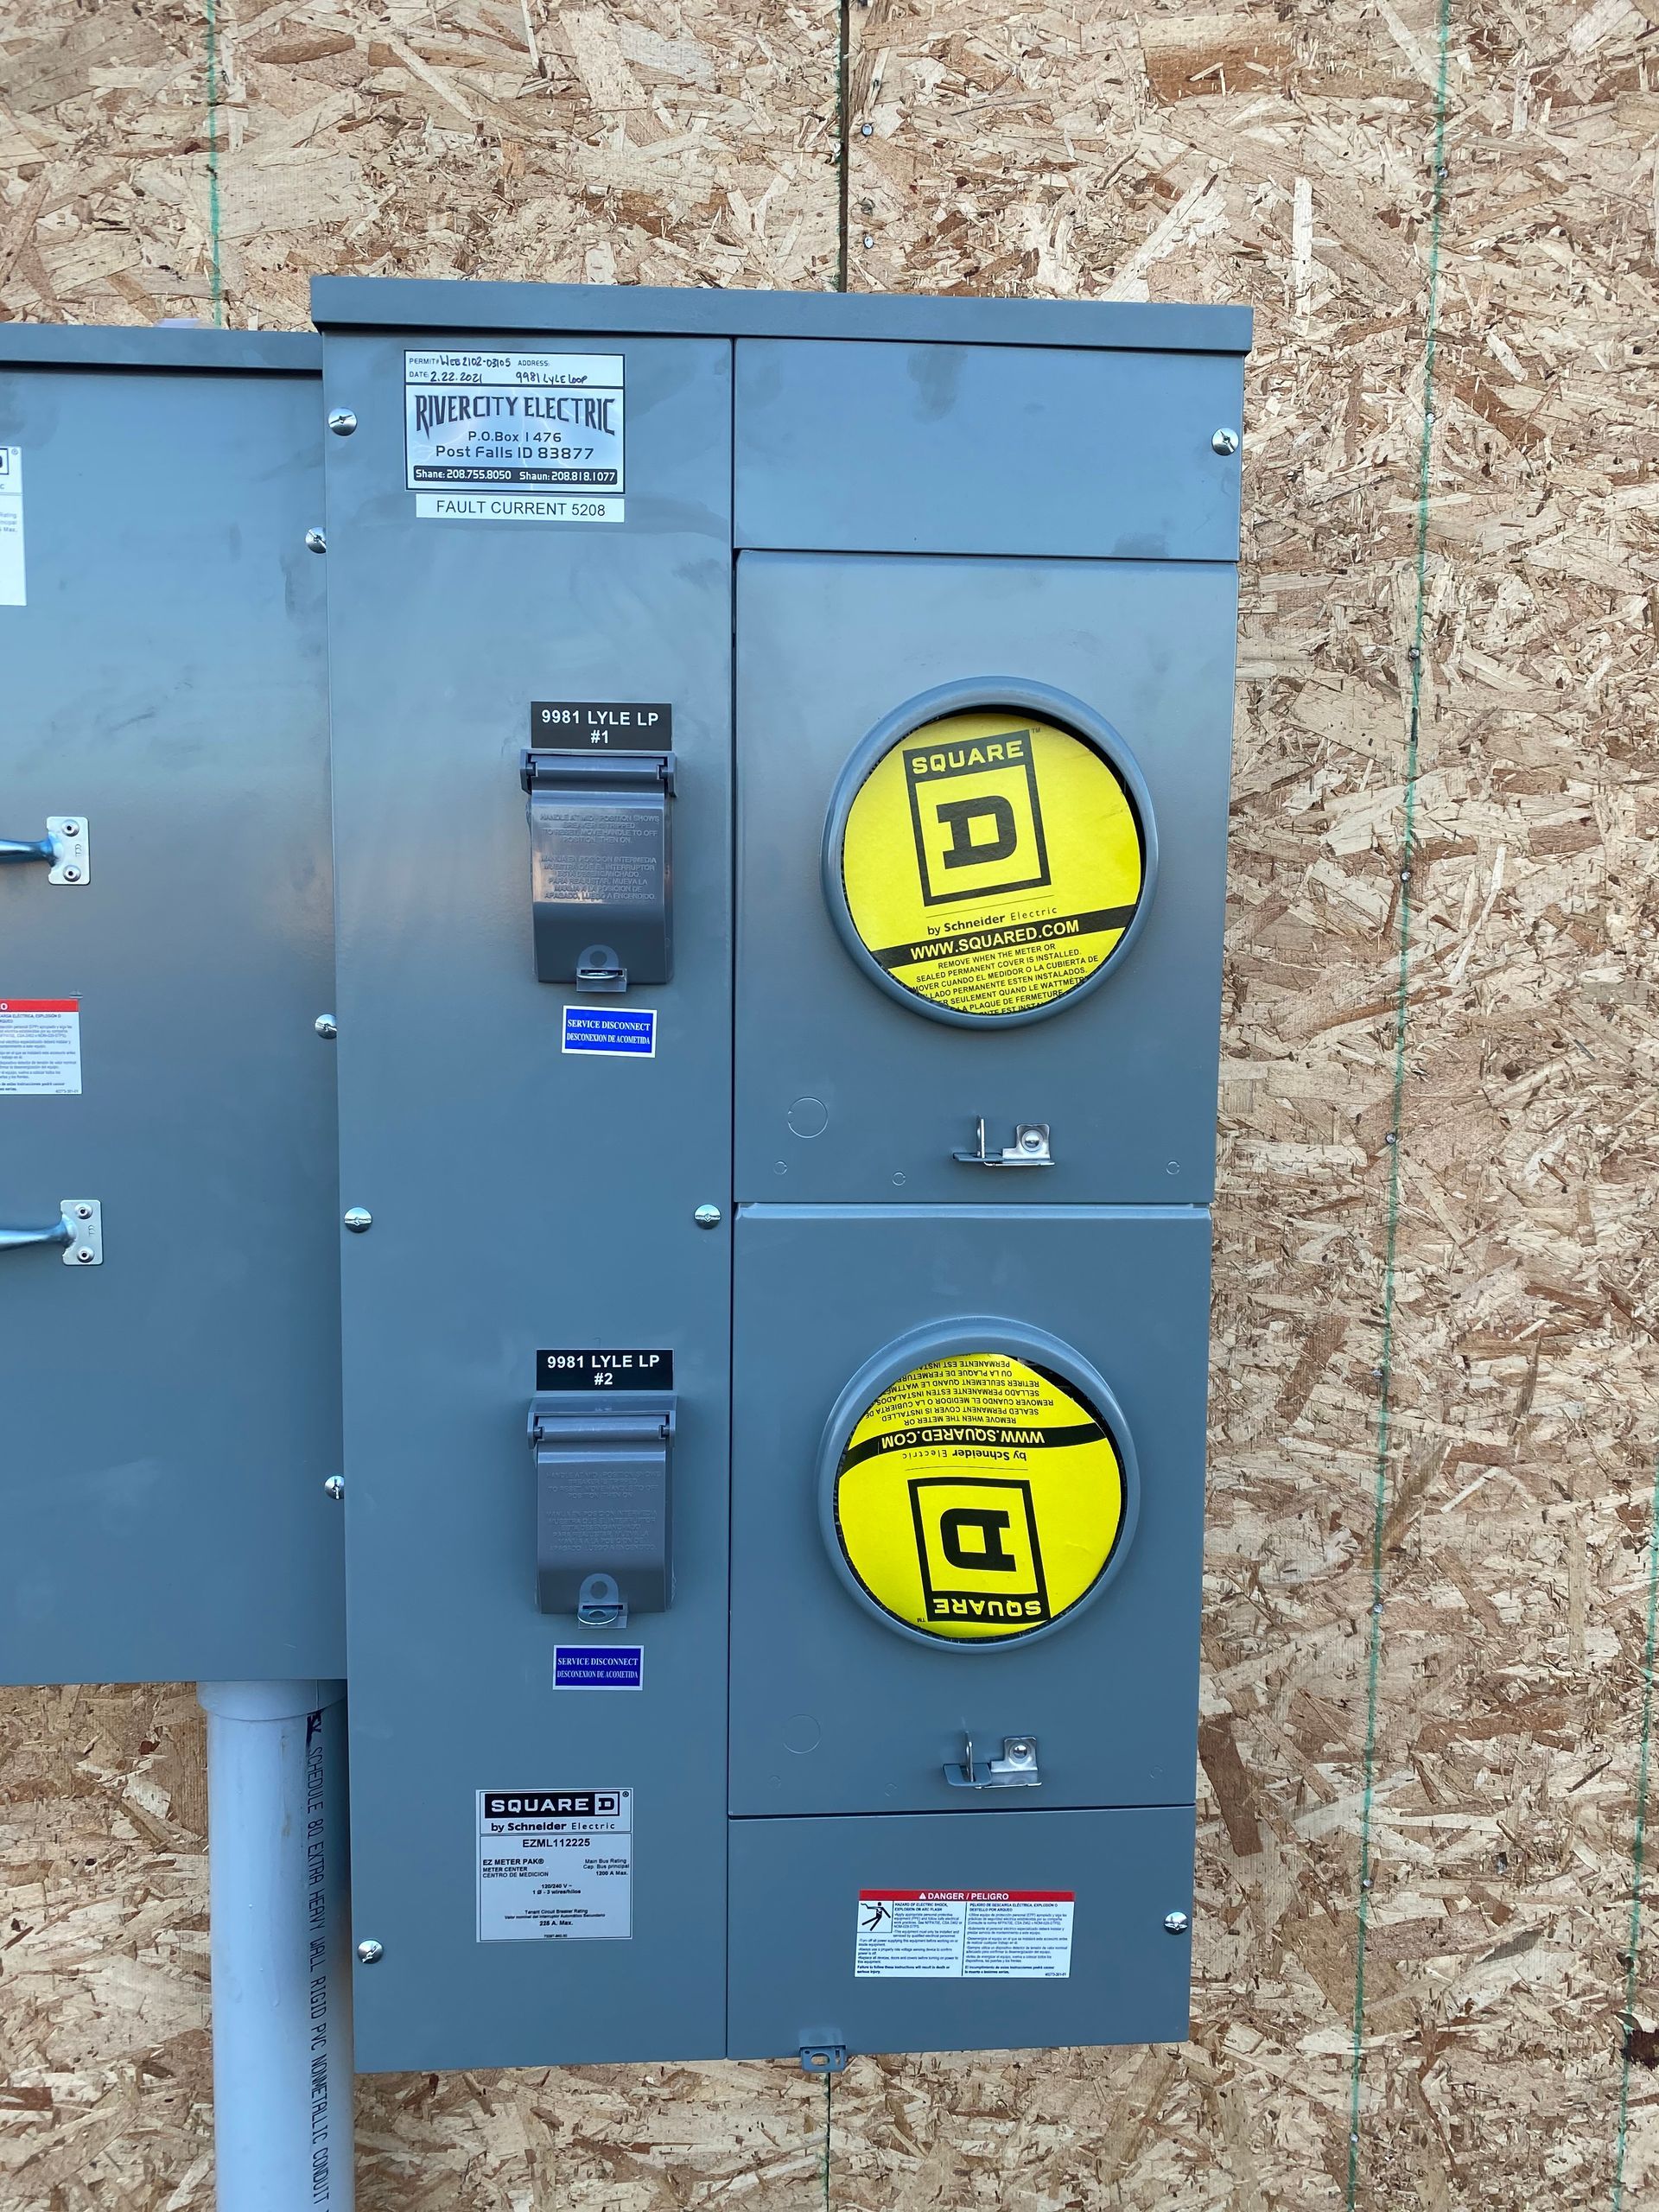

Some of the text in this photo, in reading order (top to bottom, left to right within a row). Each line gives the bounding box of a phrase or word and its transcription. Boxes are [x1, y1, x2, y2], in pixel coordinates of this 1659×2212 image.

[516, 372, 539, 383] 9981
[524, 397, 615, 435] ELECTRIC
[436, 446, 594, 459] Post Falls ID 83877
[416, 469, 615, 481] Shane: 208.755.8050 Shaun: 208.818.1077
[437, 500, 605, 516] FAULT CURRENT 5208
[542, 709, 658, 726] 9981 LYLE LP
[591, 730, 608, 743] #1
[912, 741, 1023, 774] SQUARE
[936, 795, 1017, 869] D
[927, 907, 1057, 935] by Schneider Electric
[911, 919, 1079, 960] WWW.SQUARED.COM
[938, 958, 970, 969] REMOVE
[972, 954, 995, 963] WHEN
[1015, 946, 1041, 955] METER
[917, 972, 945, 982] SEALED
[948, 963, 995, 976] PERMANENT
[998, 958, 1025, 968] COVER
[942, 976, 974, 988] CUANDO
[988, 969, 1024, 979] MEDIDOR
[1046, 959, 1085, 969] CUBIERTA
[953, 980, 1006, 995] PERMANENTE
[1008, 976, 1033, 984] ESTEN
[951, 991, 996, 1004] SEULEMENT
[999, 985, 1027, 995] QUAND
[969, 1000, 1001, 1010] PLAQUE
[568, 1020, 650, 1031] SERVICE DISCONNECT
[567, 1033, 607, 1042] DESCONEXION
[548, 1355, 659, 1368] 9981 LYLE LP
[594, 1373, 613, 1385] #2
[876, 1402, 913, 1414] CUBIERTA
[881, 1428, 1045, 1449] WWW.SQUARED.COM
[903, 1449, 1027, 1461] by Schneider Electric
[940, 1508, 1016, 1572] D
[934, 1599, 1041, 1616] SQUARE
[492, 1797, 614, 1813] SQUARE D
[492, 1823, 505, 1833] by
[508, 1822, 566, 1831] Schneider
[523, 1839, 590, 1847] EZML112225
[308, 1746, 329, 2205] SCHEDULE 80 EXTRA HEAVY WALL RIGID PVC NONMETALLIC CONDUIT
